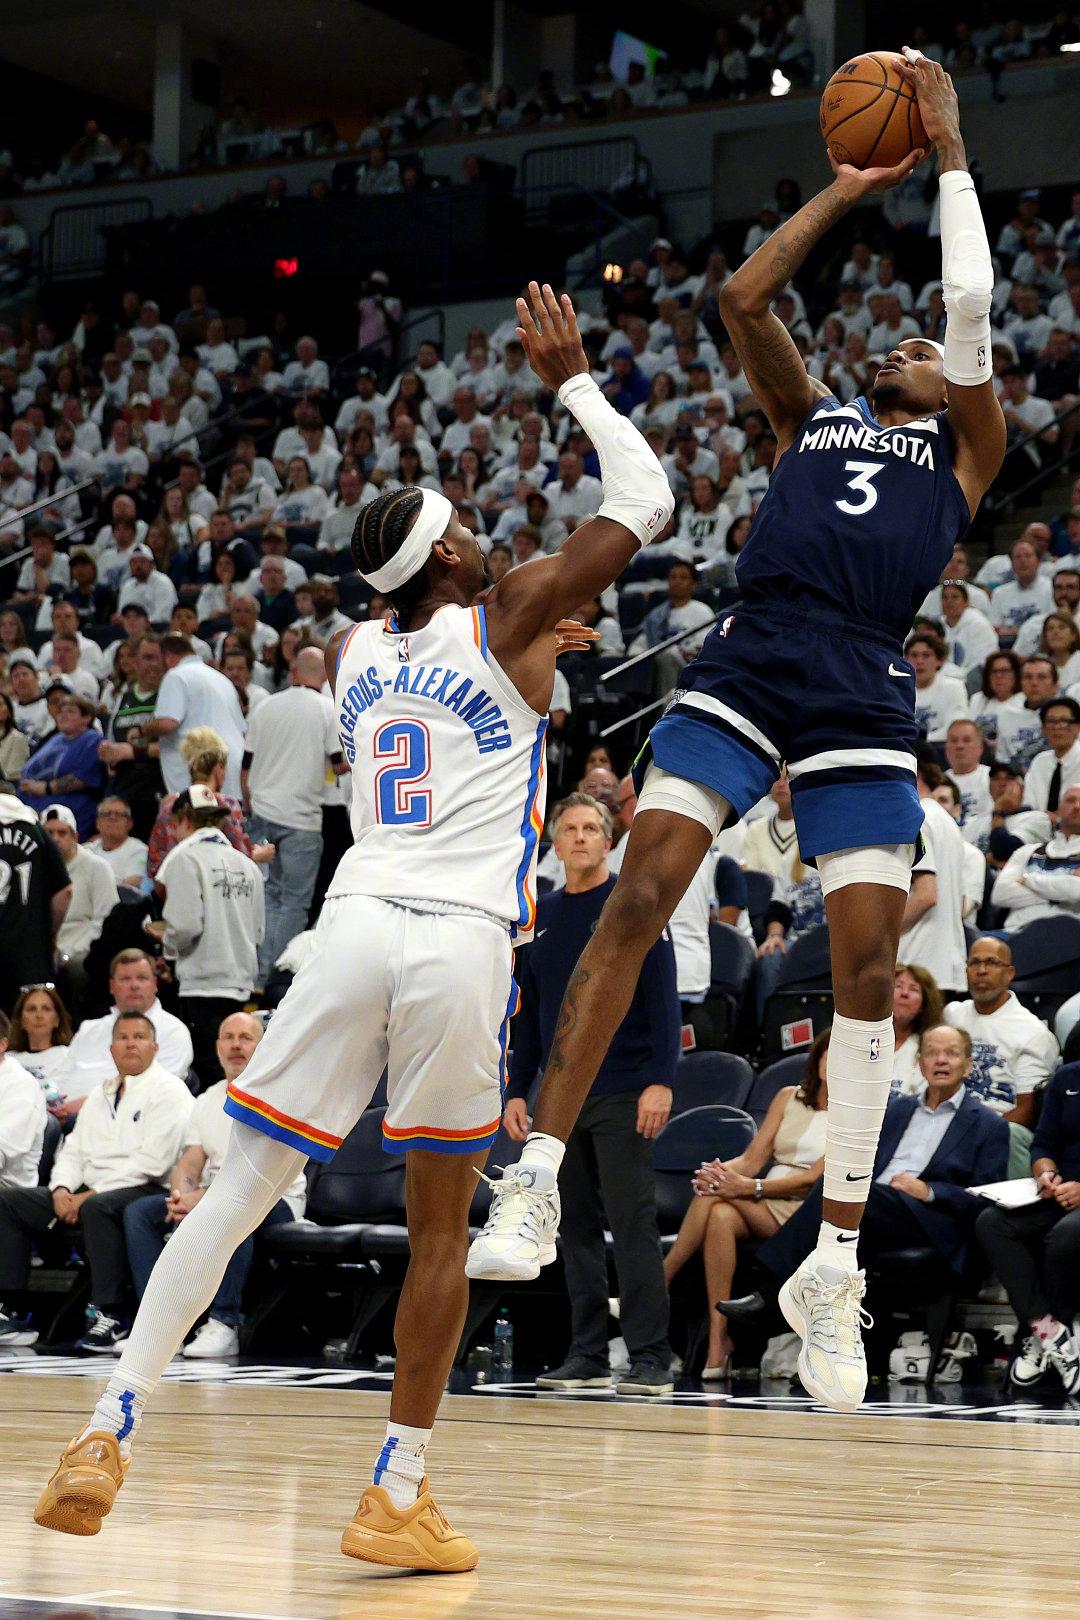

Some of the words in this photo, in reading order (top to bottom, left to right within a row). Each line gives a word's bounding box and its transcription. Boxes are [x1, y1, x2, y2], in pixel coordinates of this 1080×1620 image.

[799, 424, 935, 471] MINNESOTA
[835, 460, 886, 515] 3
[339, 665, 512, 764] GILGEOUS-ALEXANDER
[374, 718, 432, 826] 2
[0, 827, 38, 856] NETT
